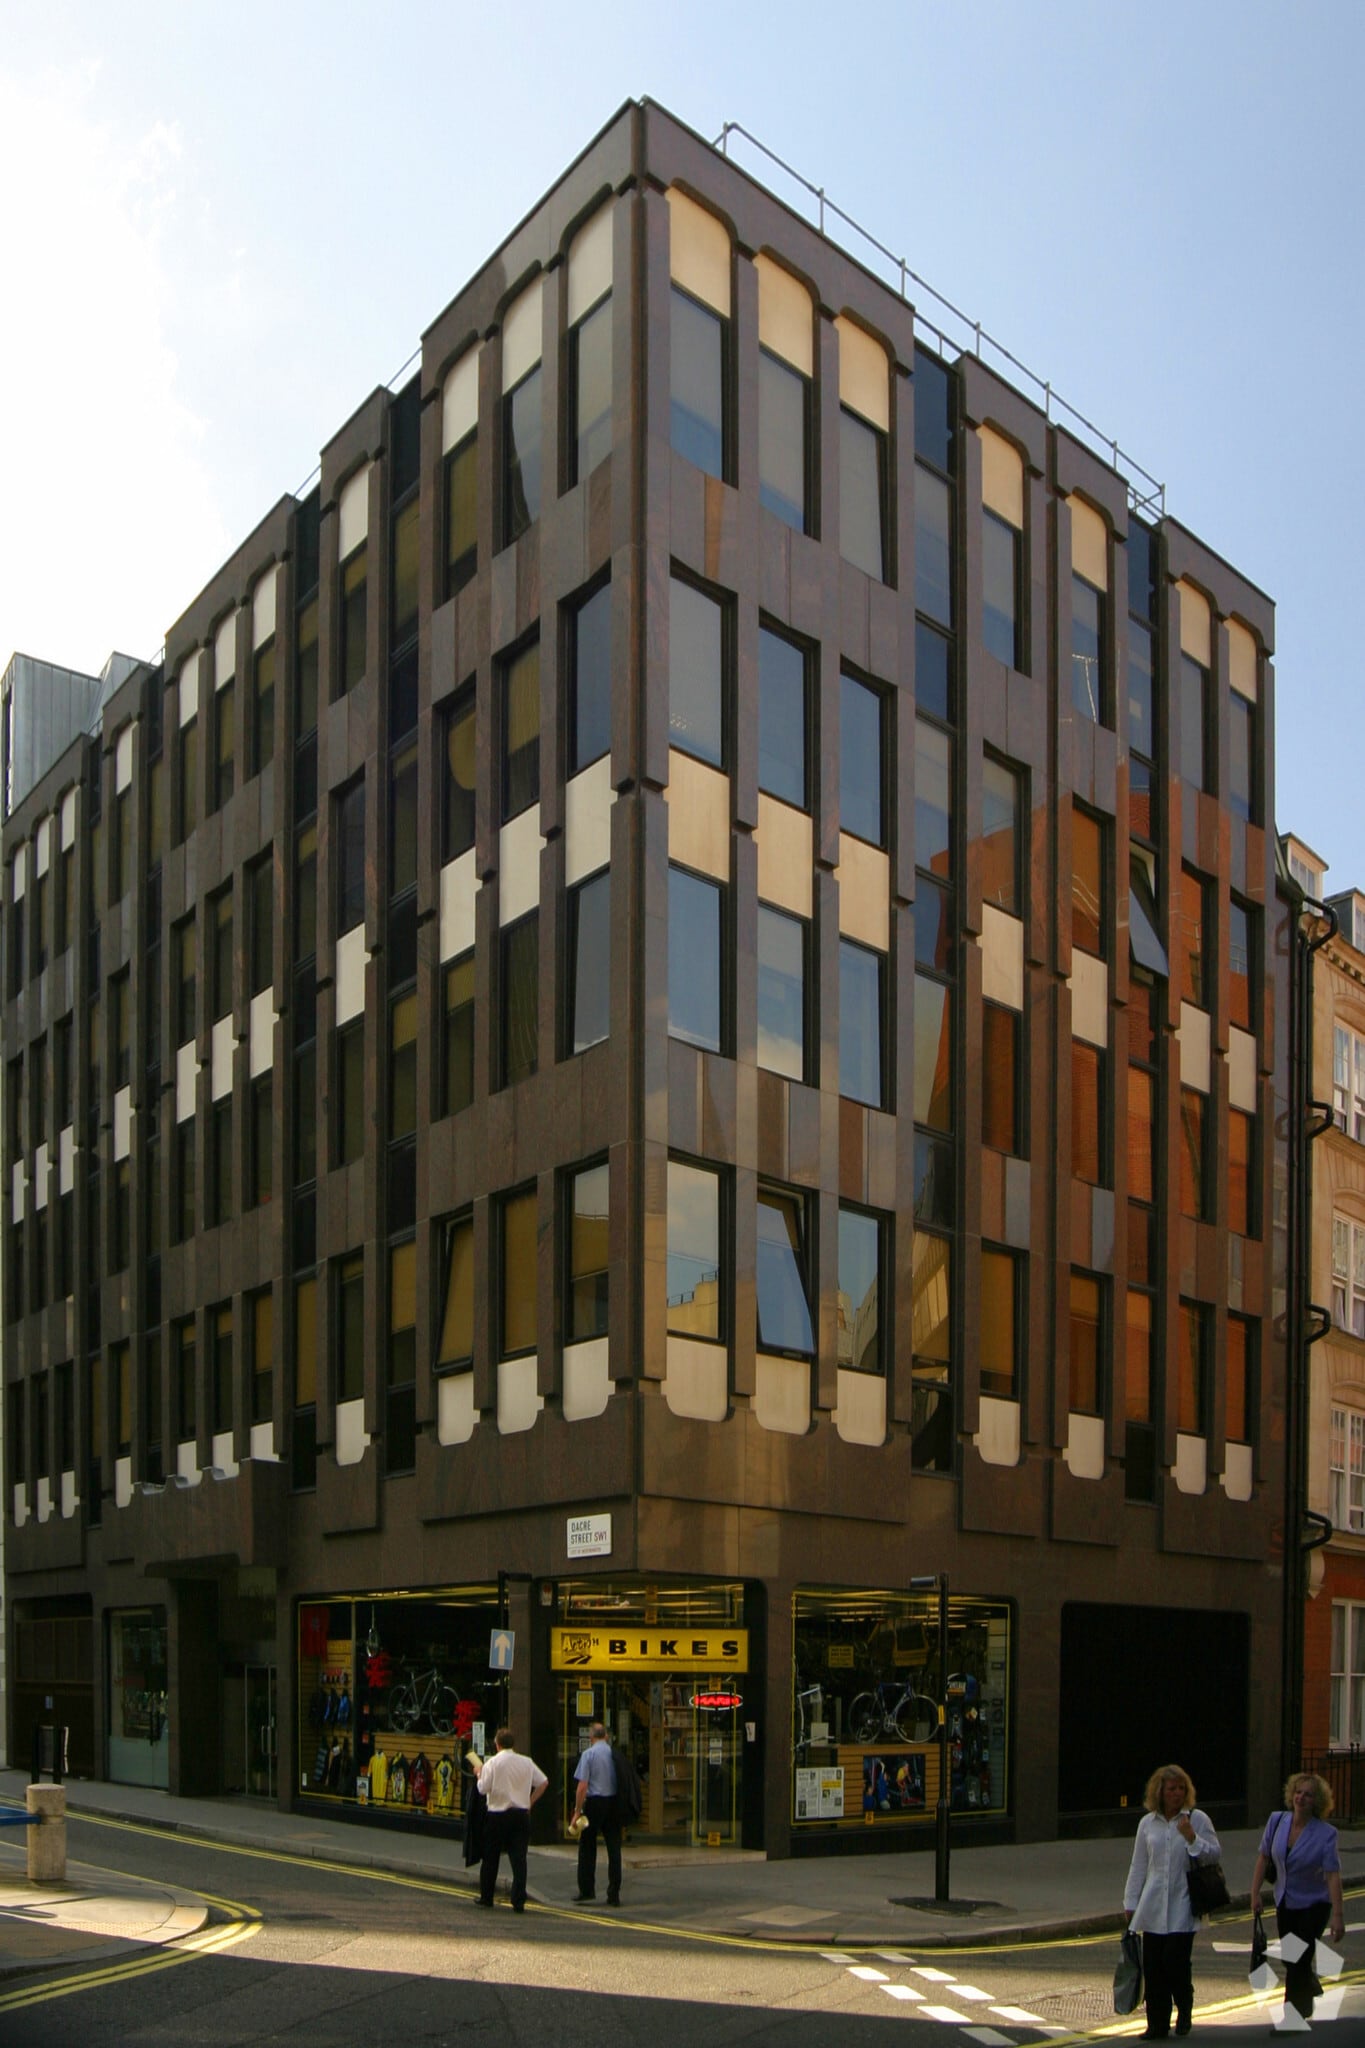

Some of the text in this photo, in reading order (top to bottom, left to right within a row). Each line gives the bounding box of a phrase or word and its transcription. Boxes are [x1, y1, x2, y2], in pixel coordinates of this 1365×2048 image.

[571, 1520, 591, 1533] DACRE
[570, 1531, 607, 1544] STREET SW1
[609, 1640, 739, 1656] BIKES
